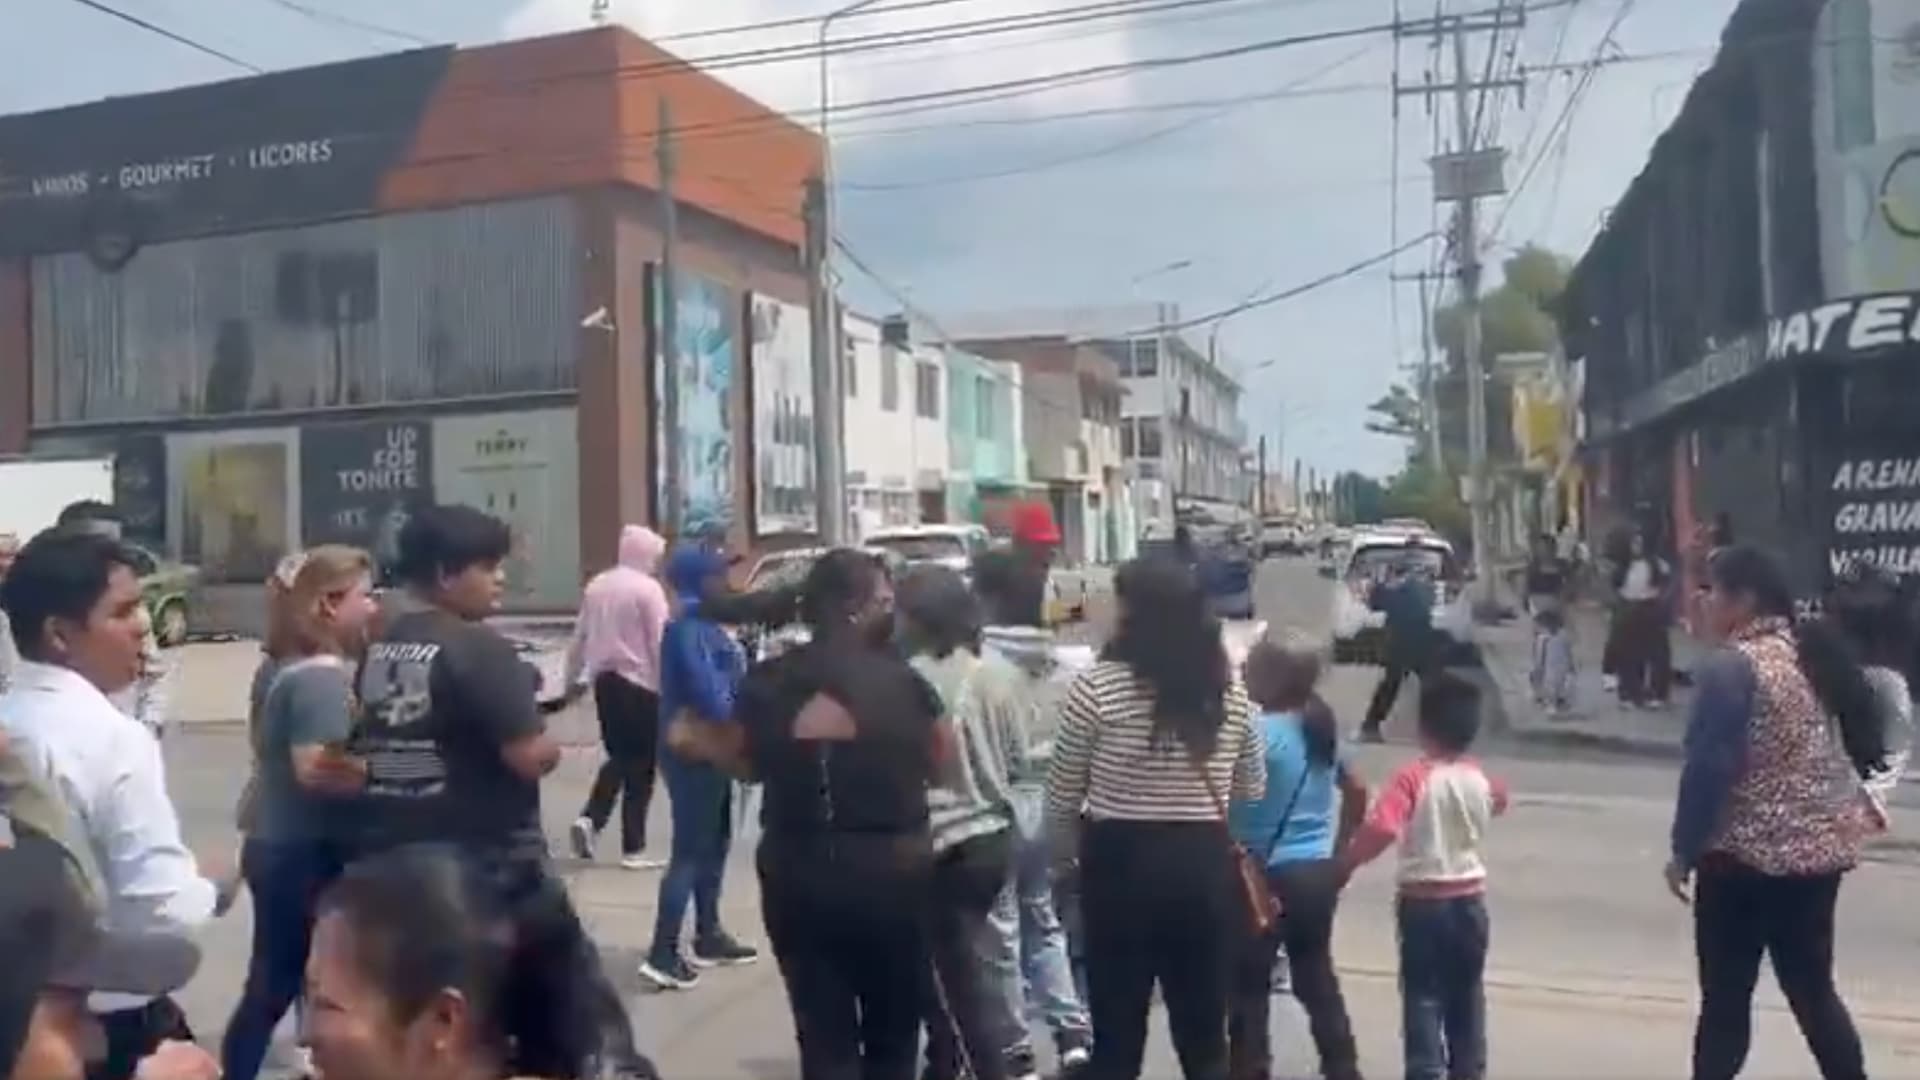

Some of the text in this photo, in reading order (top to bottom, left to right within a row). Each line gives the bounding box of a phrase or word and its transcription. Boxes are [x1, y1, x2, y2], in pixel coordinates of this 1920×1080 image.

[119, 154, 215, 189] GOURMET
[249, 138, 332, 168] LICORES
[1765, 295, 1920, 360] MATE
[386, 426, 417, 449] UP
[373, 448, 417, 469] FOR
[337, 468, 418, 491] TONITE
